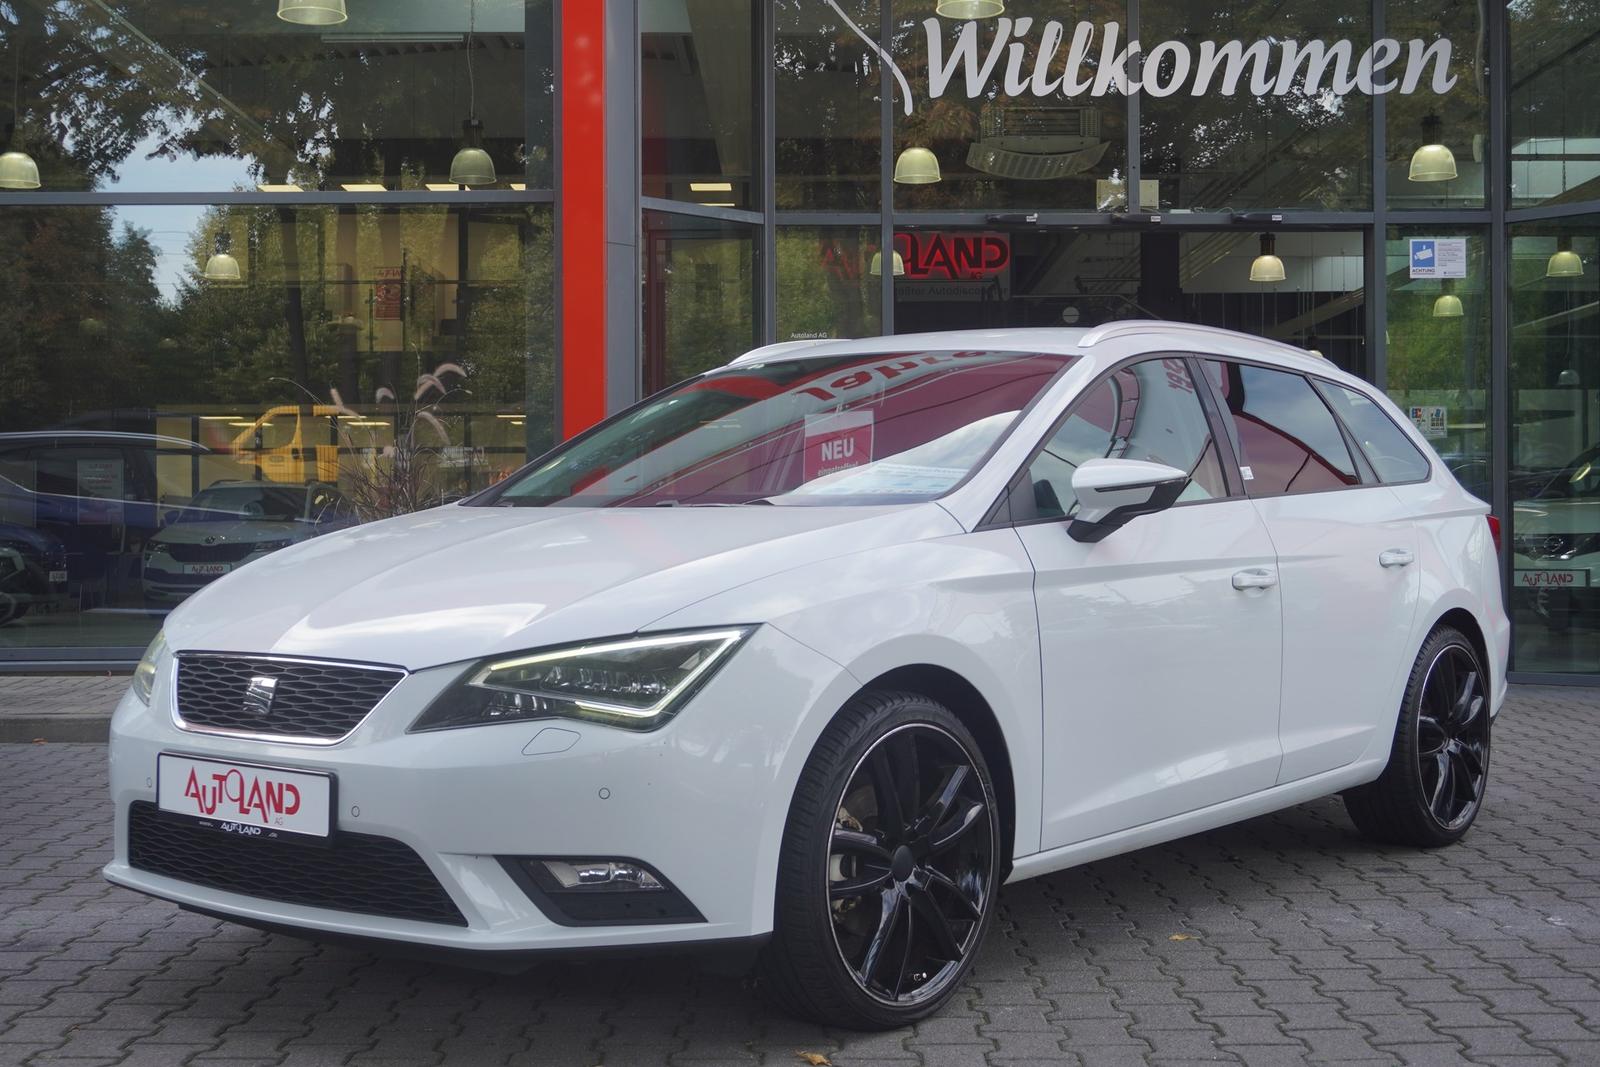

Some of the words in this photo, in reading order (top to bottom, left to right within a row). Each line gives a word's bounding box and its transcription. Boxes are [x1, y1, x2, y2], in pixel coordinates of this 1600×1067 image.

[922, 17, 1458, 99] Willkommen
[790, 331, 817, 339] Autoland
[818, 331, 828, 339] AG
[821, 436, 854, 462] NEU
[1522, 570, 1574, 586] AUTOLAND
[184, 766, 302, 824] AUTOLAND
[220, 821, 262, 836] AUTOLAND
[274, 816, 284, 825] AG
